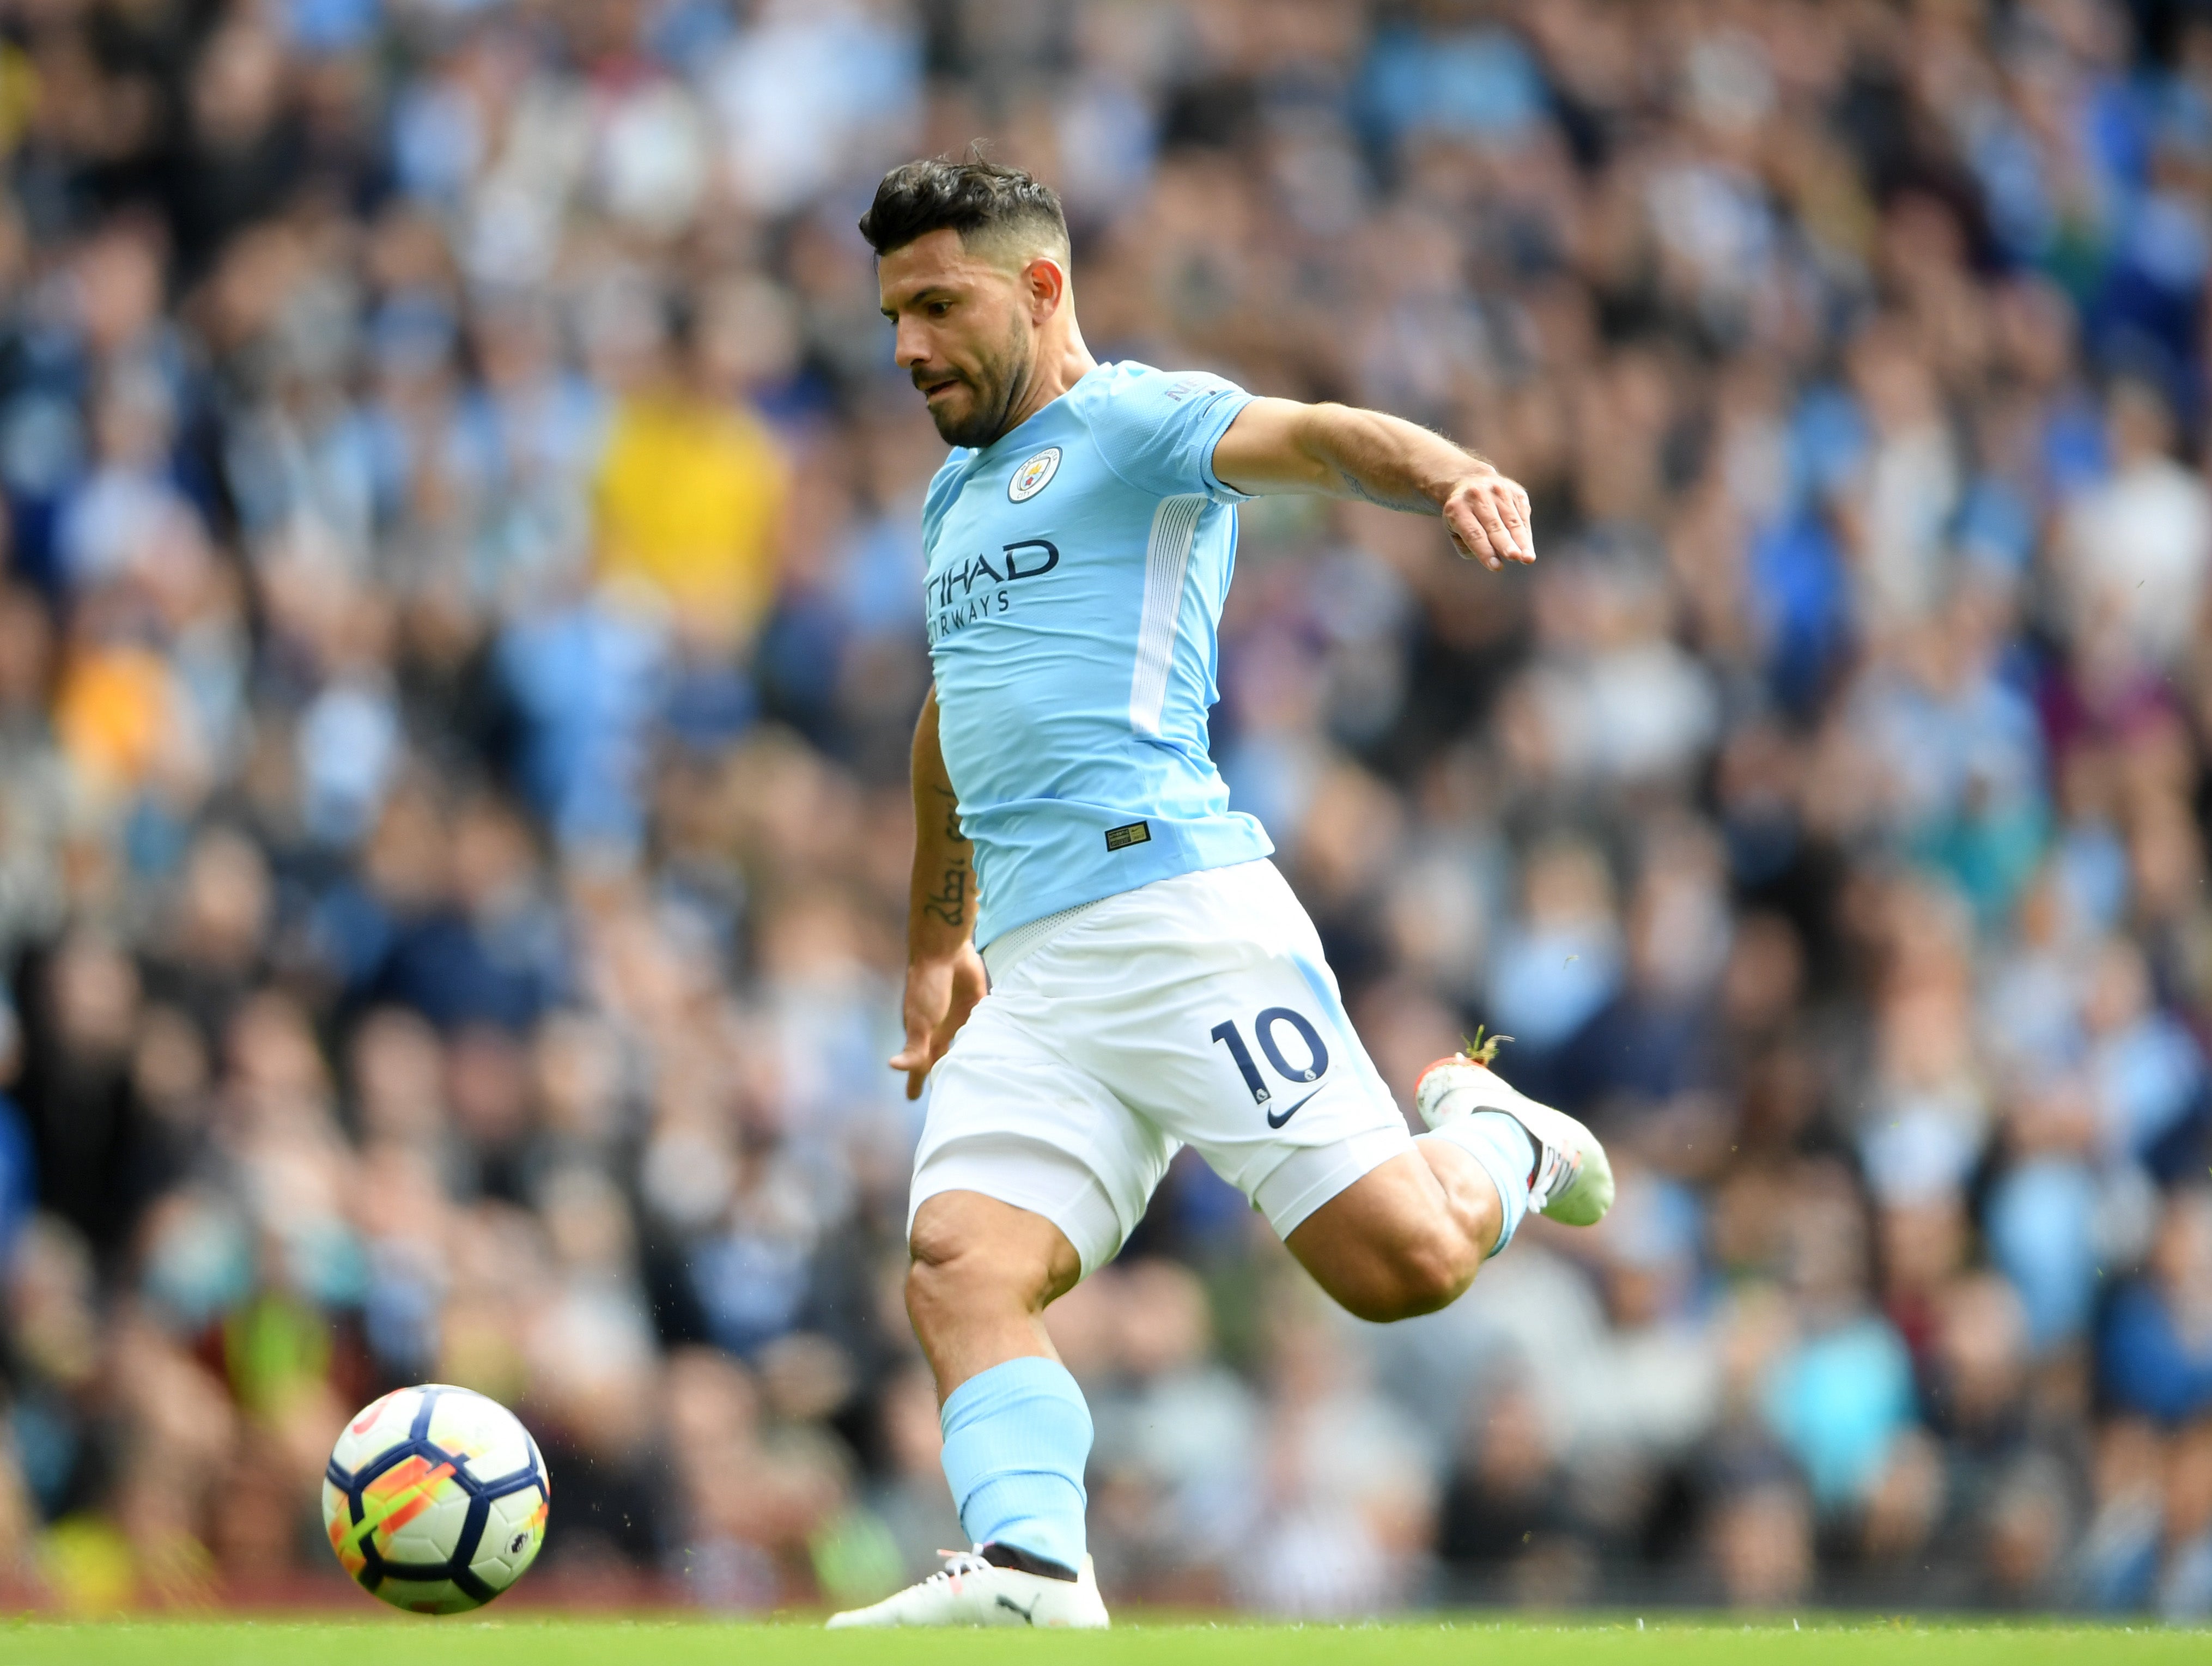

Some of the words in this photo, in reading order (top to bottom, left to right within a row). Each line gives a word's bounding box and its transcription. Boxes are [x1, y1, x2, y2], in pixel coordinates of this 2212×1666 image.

[1017, 491, 1030, 499] CITY
[928, 539, 1060, 618] TIHAD
[928, 590, 1009, 641] IRWAYS
[1211, 1006, 1329, 1105] 10
